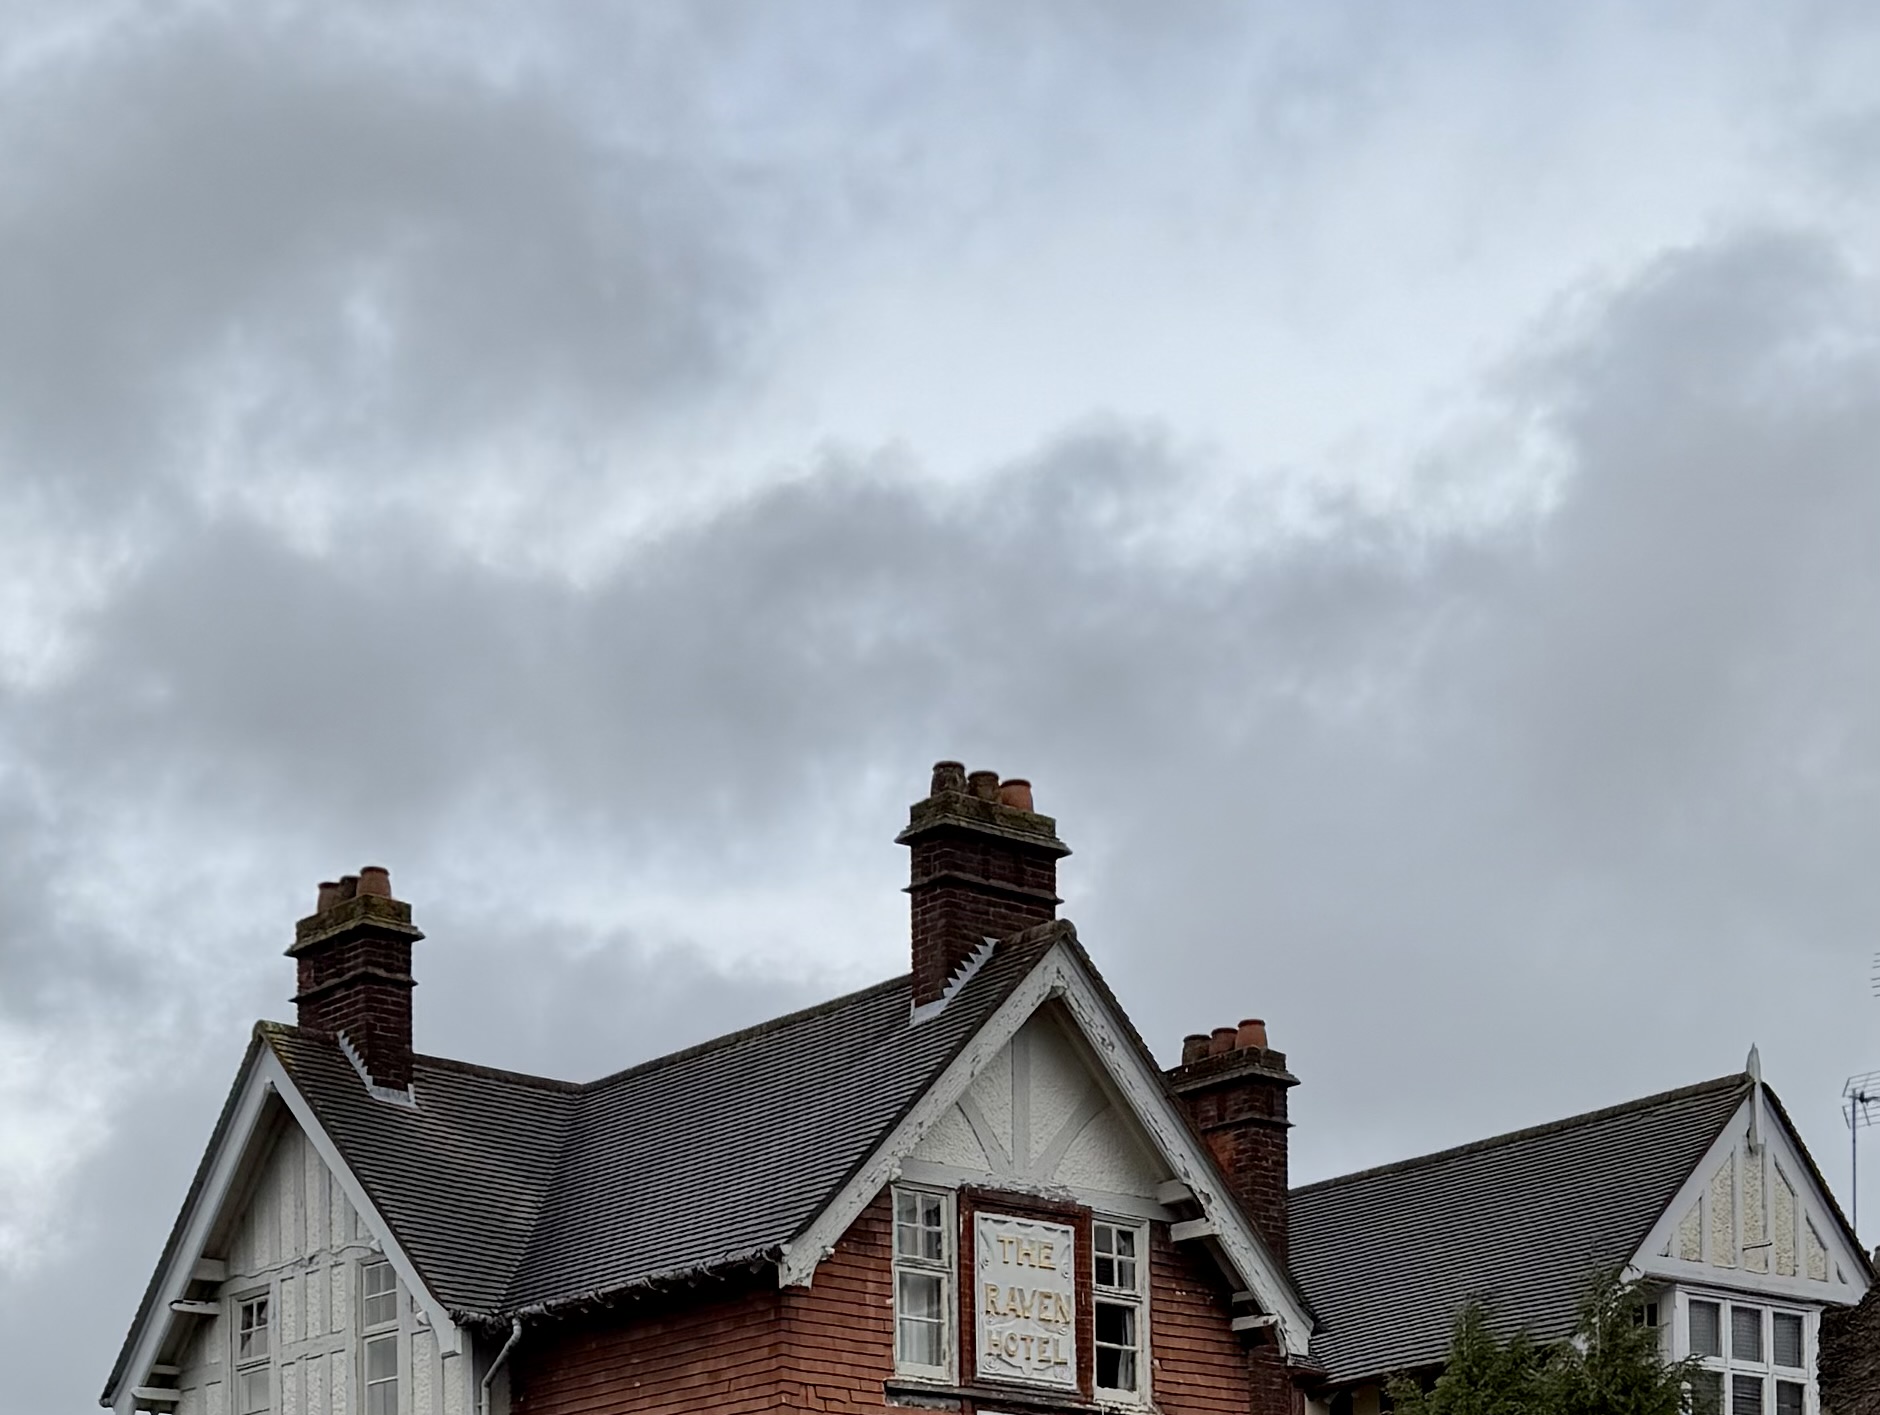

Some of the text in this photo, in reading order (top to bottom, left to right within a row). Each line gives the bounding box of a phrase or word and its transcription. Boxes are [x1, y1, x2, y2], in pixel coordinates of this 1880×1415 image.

[996, 1235, 1056, 1270] THE
[984, 1282, 1070, 1324] RAVEN
[986, 1331, 1068, 1365] HOTEL
